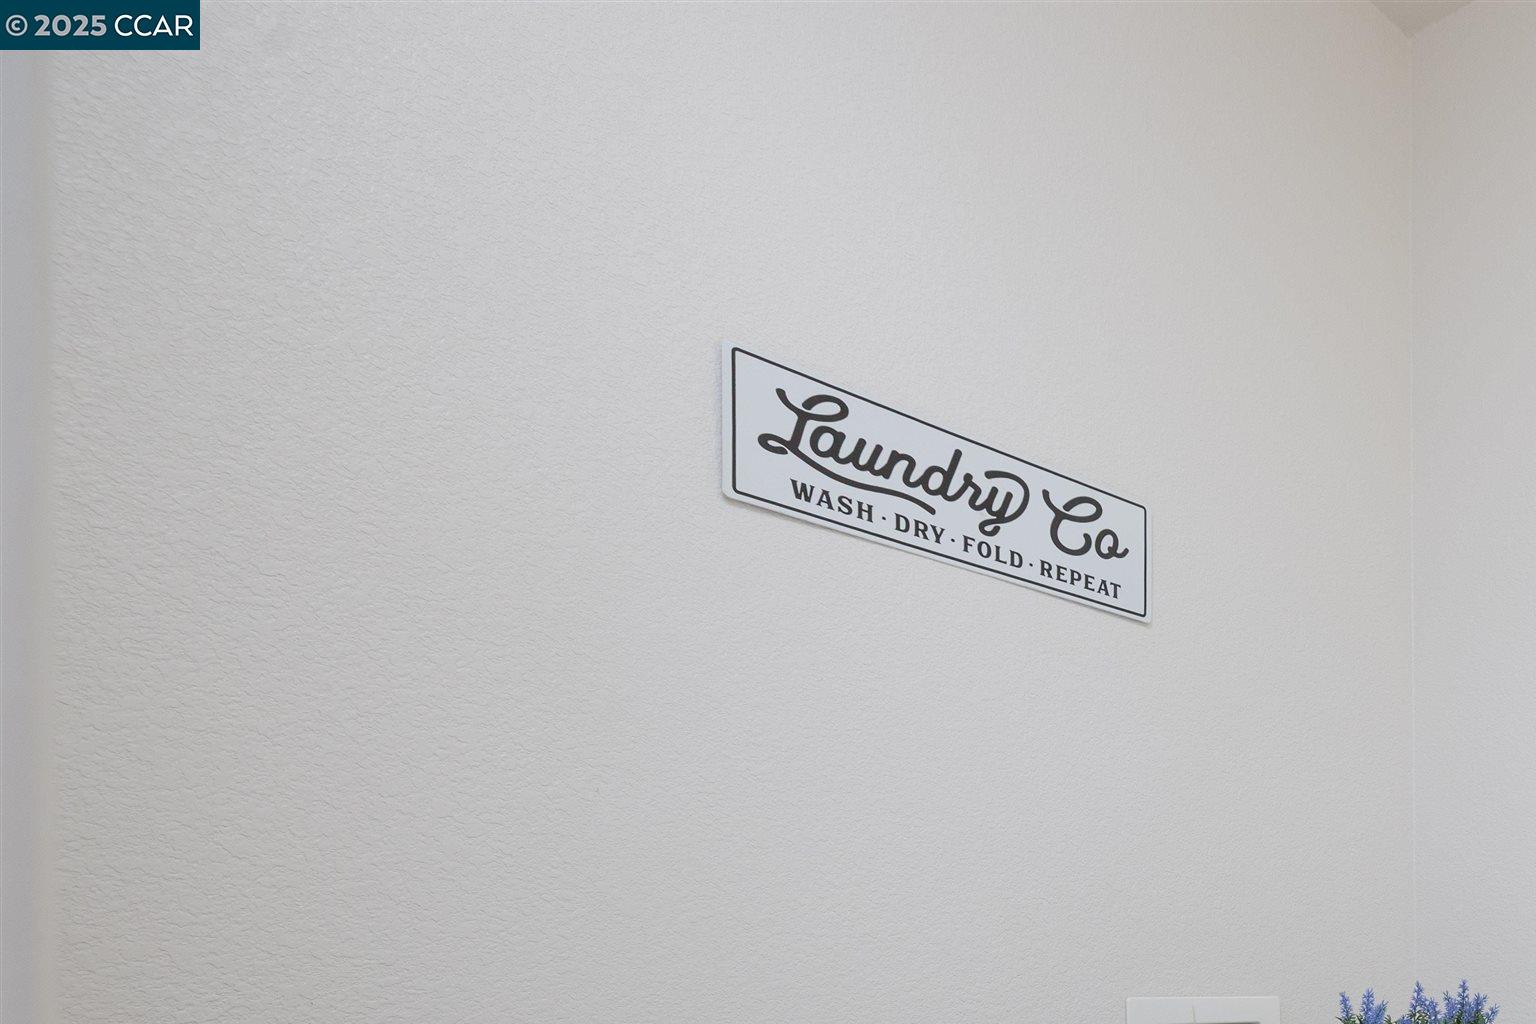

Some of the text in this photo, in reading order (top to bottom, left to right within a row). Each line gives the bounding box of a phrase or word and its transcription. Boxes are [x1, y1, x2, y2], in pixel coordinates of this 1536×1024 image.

[758, 388, 1129, 559] Laundry Co
[790, 479, 1122, 600] WASH DRY FOLD REPEAT
